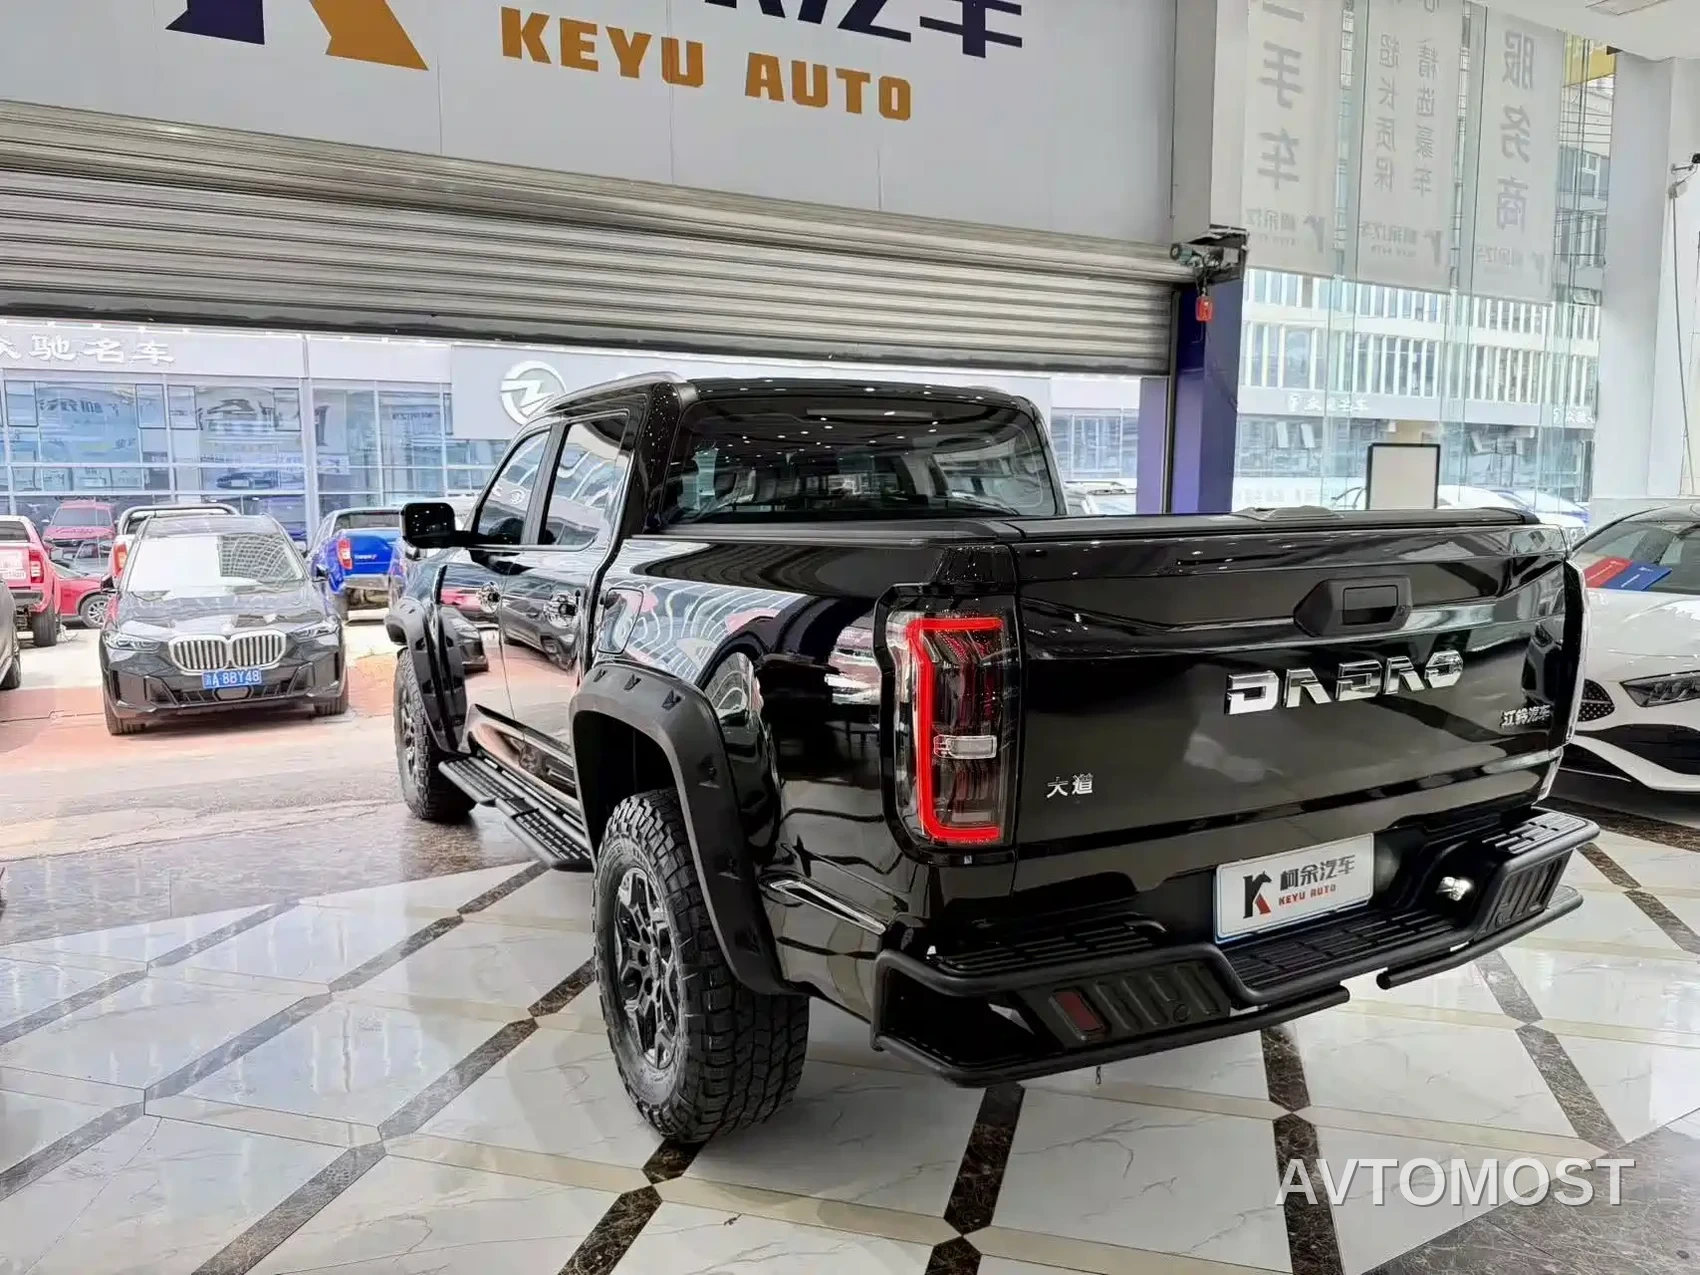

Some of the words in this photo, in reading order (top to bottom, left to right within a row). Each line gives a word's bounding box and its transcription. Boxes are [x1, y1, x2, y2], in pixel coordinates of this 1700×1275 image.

[501, 6, 704, 89] KEYU
[745, 52, 912, 122] AUTO
[1046, 773, 1093, 799] 大道
[1280, 854, 1355, 891] 柯余汽车
[1278, 892, 1306, 906] KEYU
[1310, 884, 1337, 898] AUTO
